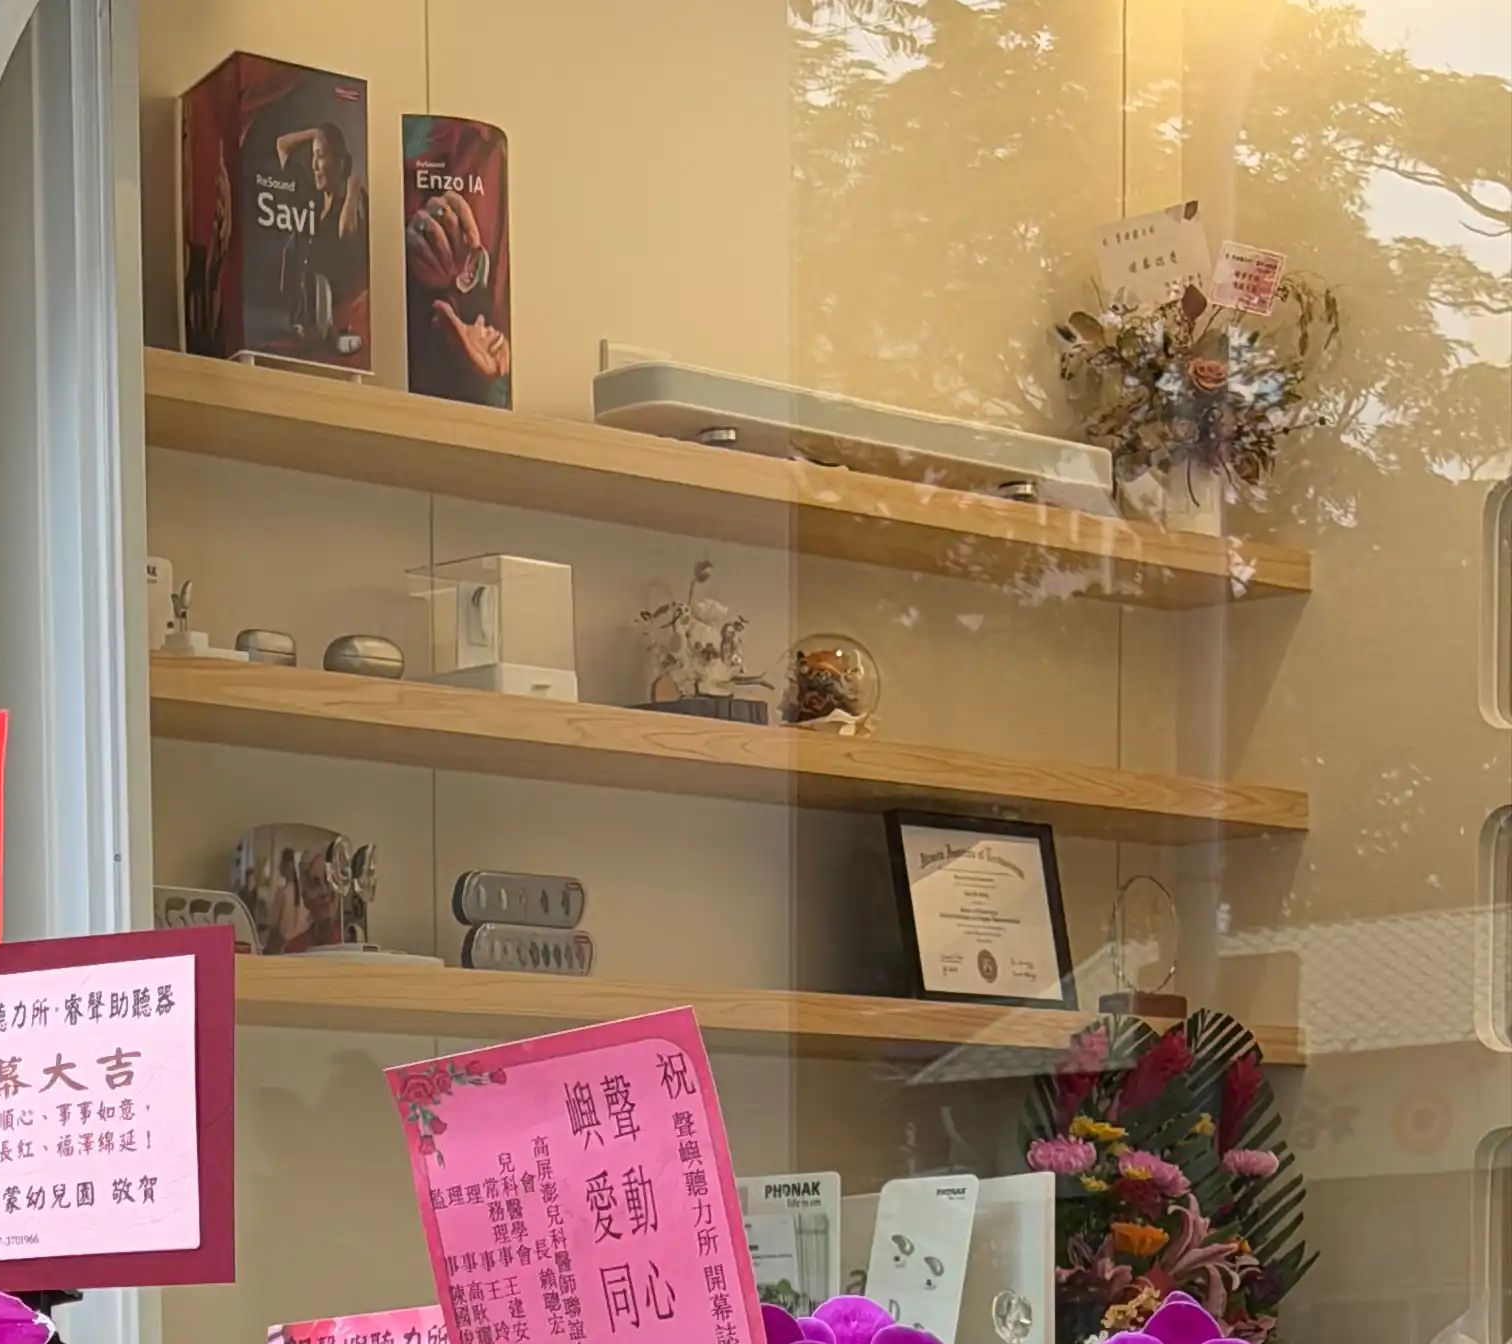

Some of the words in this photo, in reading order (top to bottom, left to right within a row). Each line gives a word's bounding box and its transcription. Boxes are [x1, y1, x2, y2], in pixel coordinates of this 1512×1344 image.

[256, 174, 296, 192] ReSound
[416, 169, 464, 192] Enzo
[257, 192, 315, 235] Savi
[656, 1052, 697, 1100] 祝
[112, 1175, 159, 1205] 敬賀
[764, 1181, 821, 1199] PHONAK
